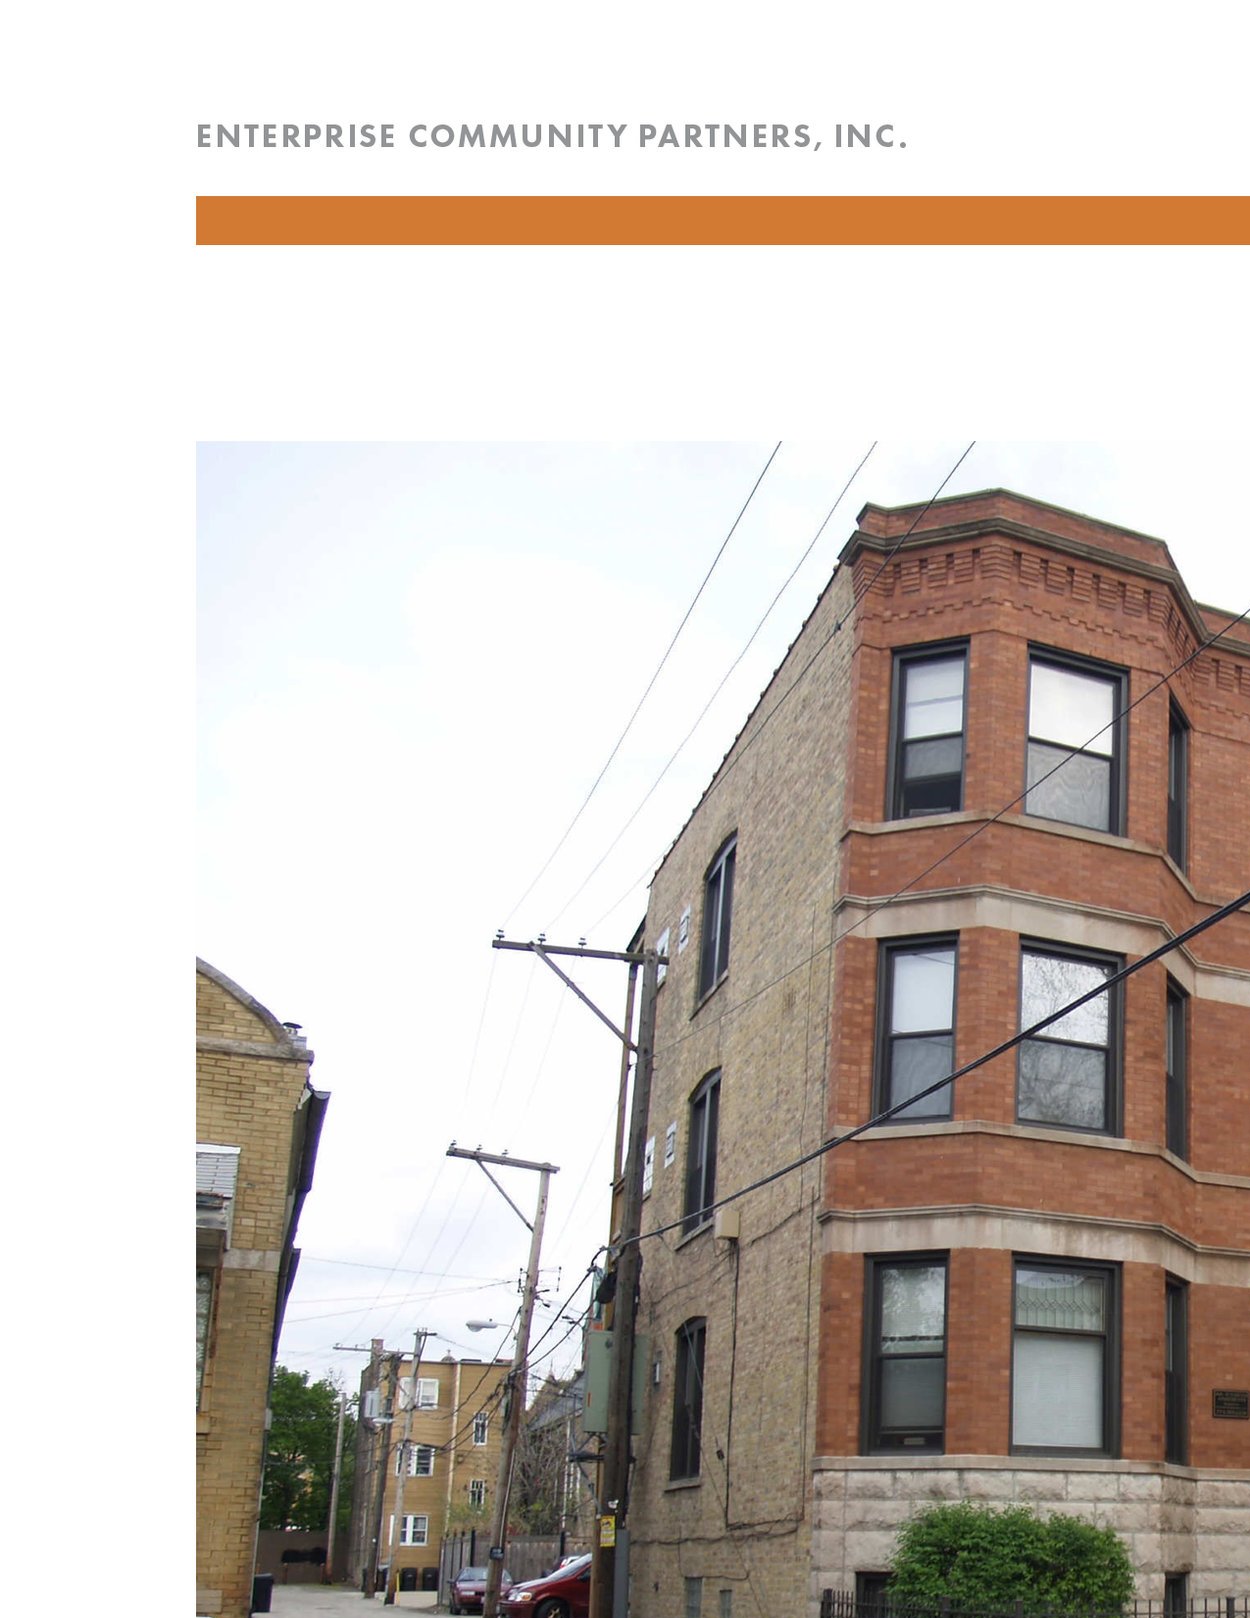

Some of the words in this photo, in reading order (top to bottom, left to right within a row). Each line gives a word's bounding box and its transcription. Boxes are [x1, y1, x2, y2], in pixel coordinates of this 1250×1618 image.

[197, 123, 395, 148] ENTERPRISE
[409, 123, 628, 148] COMMUNITY
[639, 123, 822, 152] PARTNERS,
[835, 123, 907, 149] INC.
